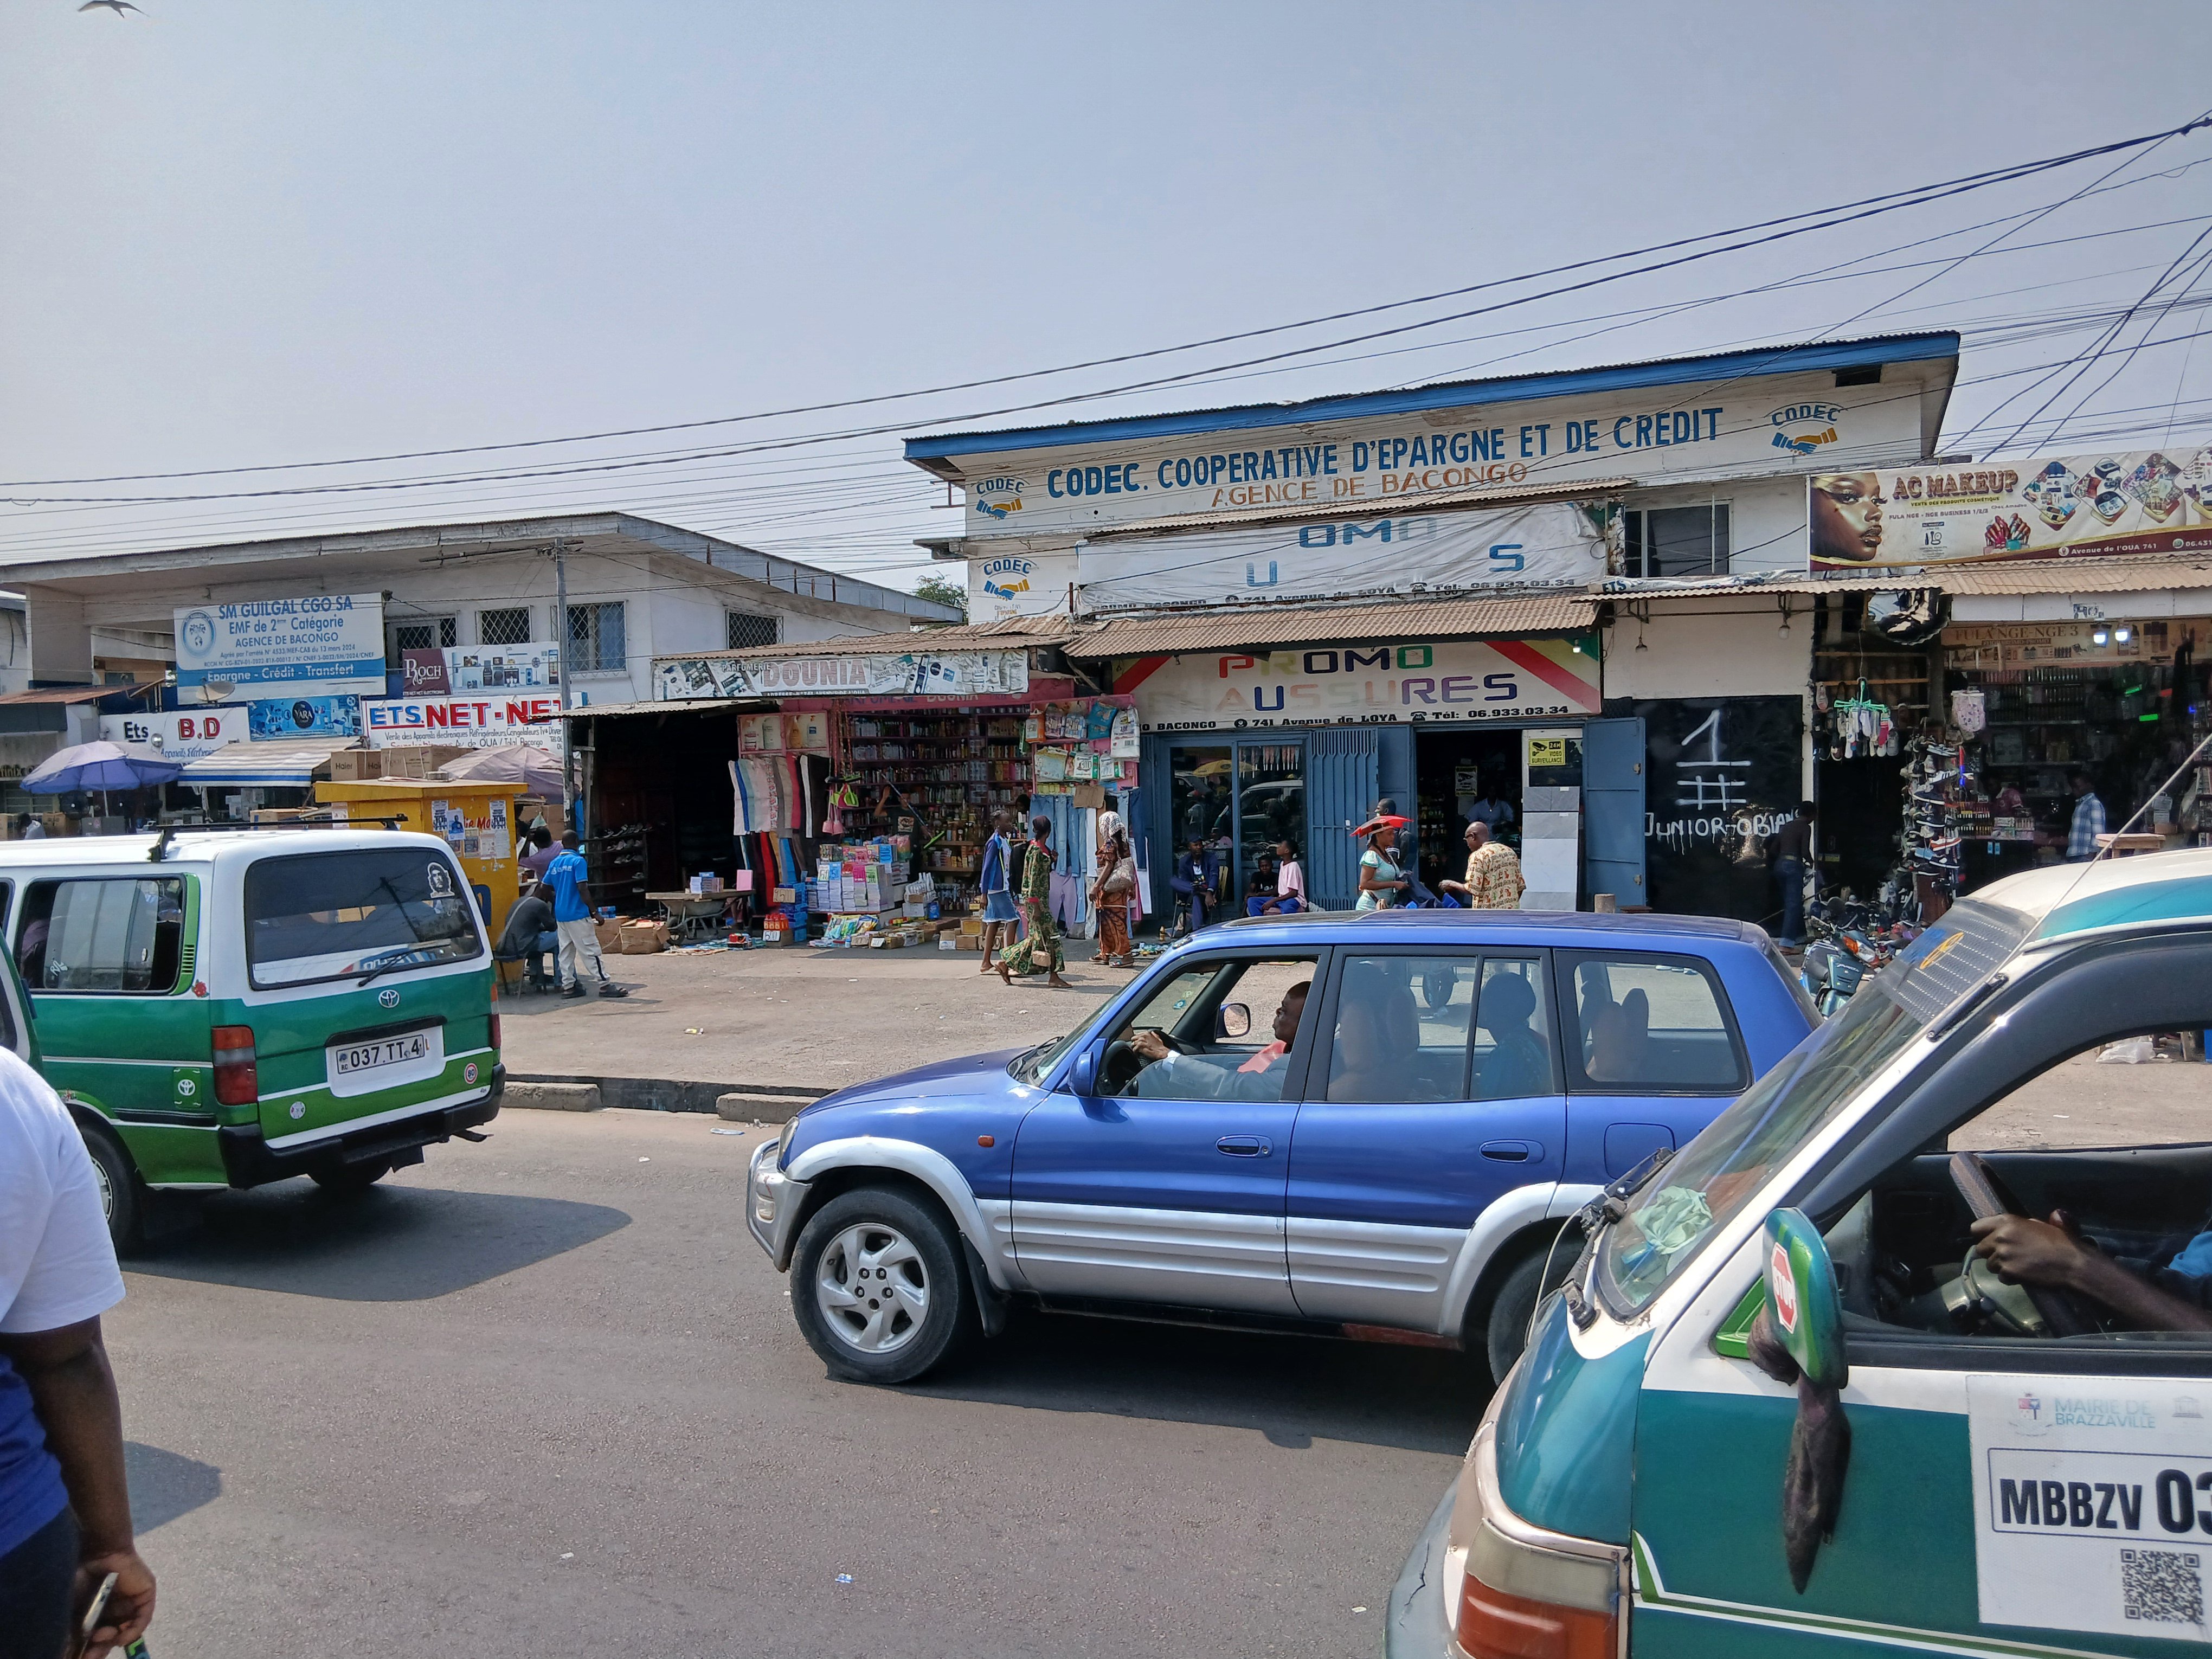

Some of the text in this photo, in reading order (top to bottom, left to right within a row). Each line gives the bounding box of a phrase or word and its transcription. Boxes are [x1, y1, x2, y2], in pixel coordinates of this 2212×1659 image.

[1771, 404, 1838, 426] CODEC
[1047, 407, 1724, 498] CODEC. COOPERATIVE D'EPARGNE ET DE CREDIT
[976, 478, 1025, 494] CODEC
[1212, 462, 1527, 508] AGENCE DE BACONGO
[1892, 469, 2019, 500] AC MAKEUP
[983, 558, 1031, 575] CODEC
[1602, 580, 1626, 593] ETS
[219, 603, 237, 620] SM
[241, 599, 297, 618] GUILGAL
[301, 597, 332, 613] CGO
[336, 595, 353, 611] SA
[229, 620, 250, 634] EMF
[254, 619, 267, 633] de
[291, 613, 344, 632] Catégorie
[235, 632, 339, 648] AGENCE DE BACONGO
[1956, 625, 2079, 641] FULA NGE-NGE 3
[262, 666, 294, 679] Crédit
[305, 663, 354, 677] Transfert
[722, 663, 770, 673] PARFUMERIE
[762, 659, 867, 687] DOUNIA
[1157, 721, 1217, 730] BACONGO
[1252, 718, 1274, 727] 741
[1282, 716, 1330, 726] Avenue
[1338, 716, 1354, 724] de
[1361, 713, 1397, 723] LOYA
[1468, 705, 1568, 718] 06.933.03.34
[124, 721, 149, 739] Ets
[385, 732, 401, 741] Vente
[402, 731, 413, 740] des
[479, 738, 498, 747] OUA
[467, 1069, 475, 1077] 80
[1773, 1265, 1795, 1309] STOP
[2055, 1397, 2153, 1415] MAIRIE DE
[2055, 1412, 2156, 1429] BRAZZAVILLE
[1999, 1478, 2143, 1531] MBBZV
